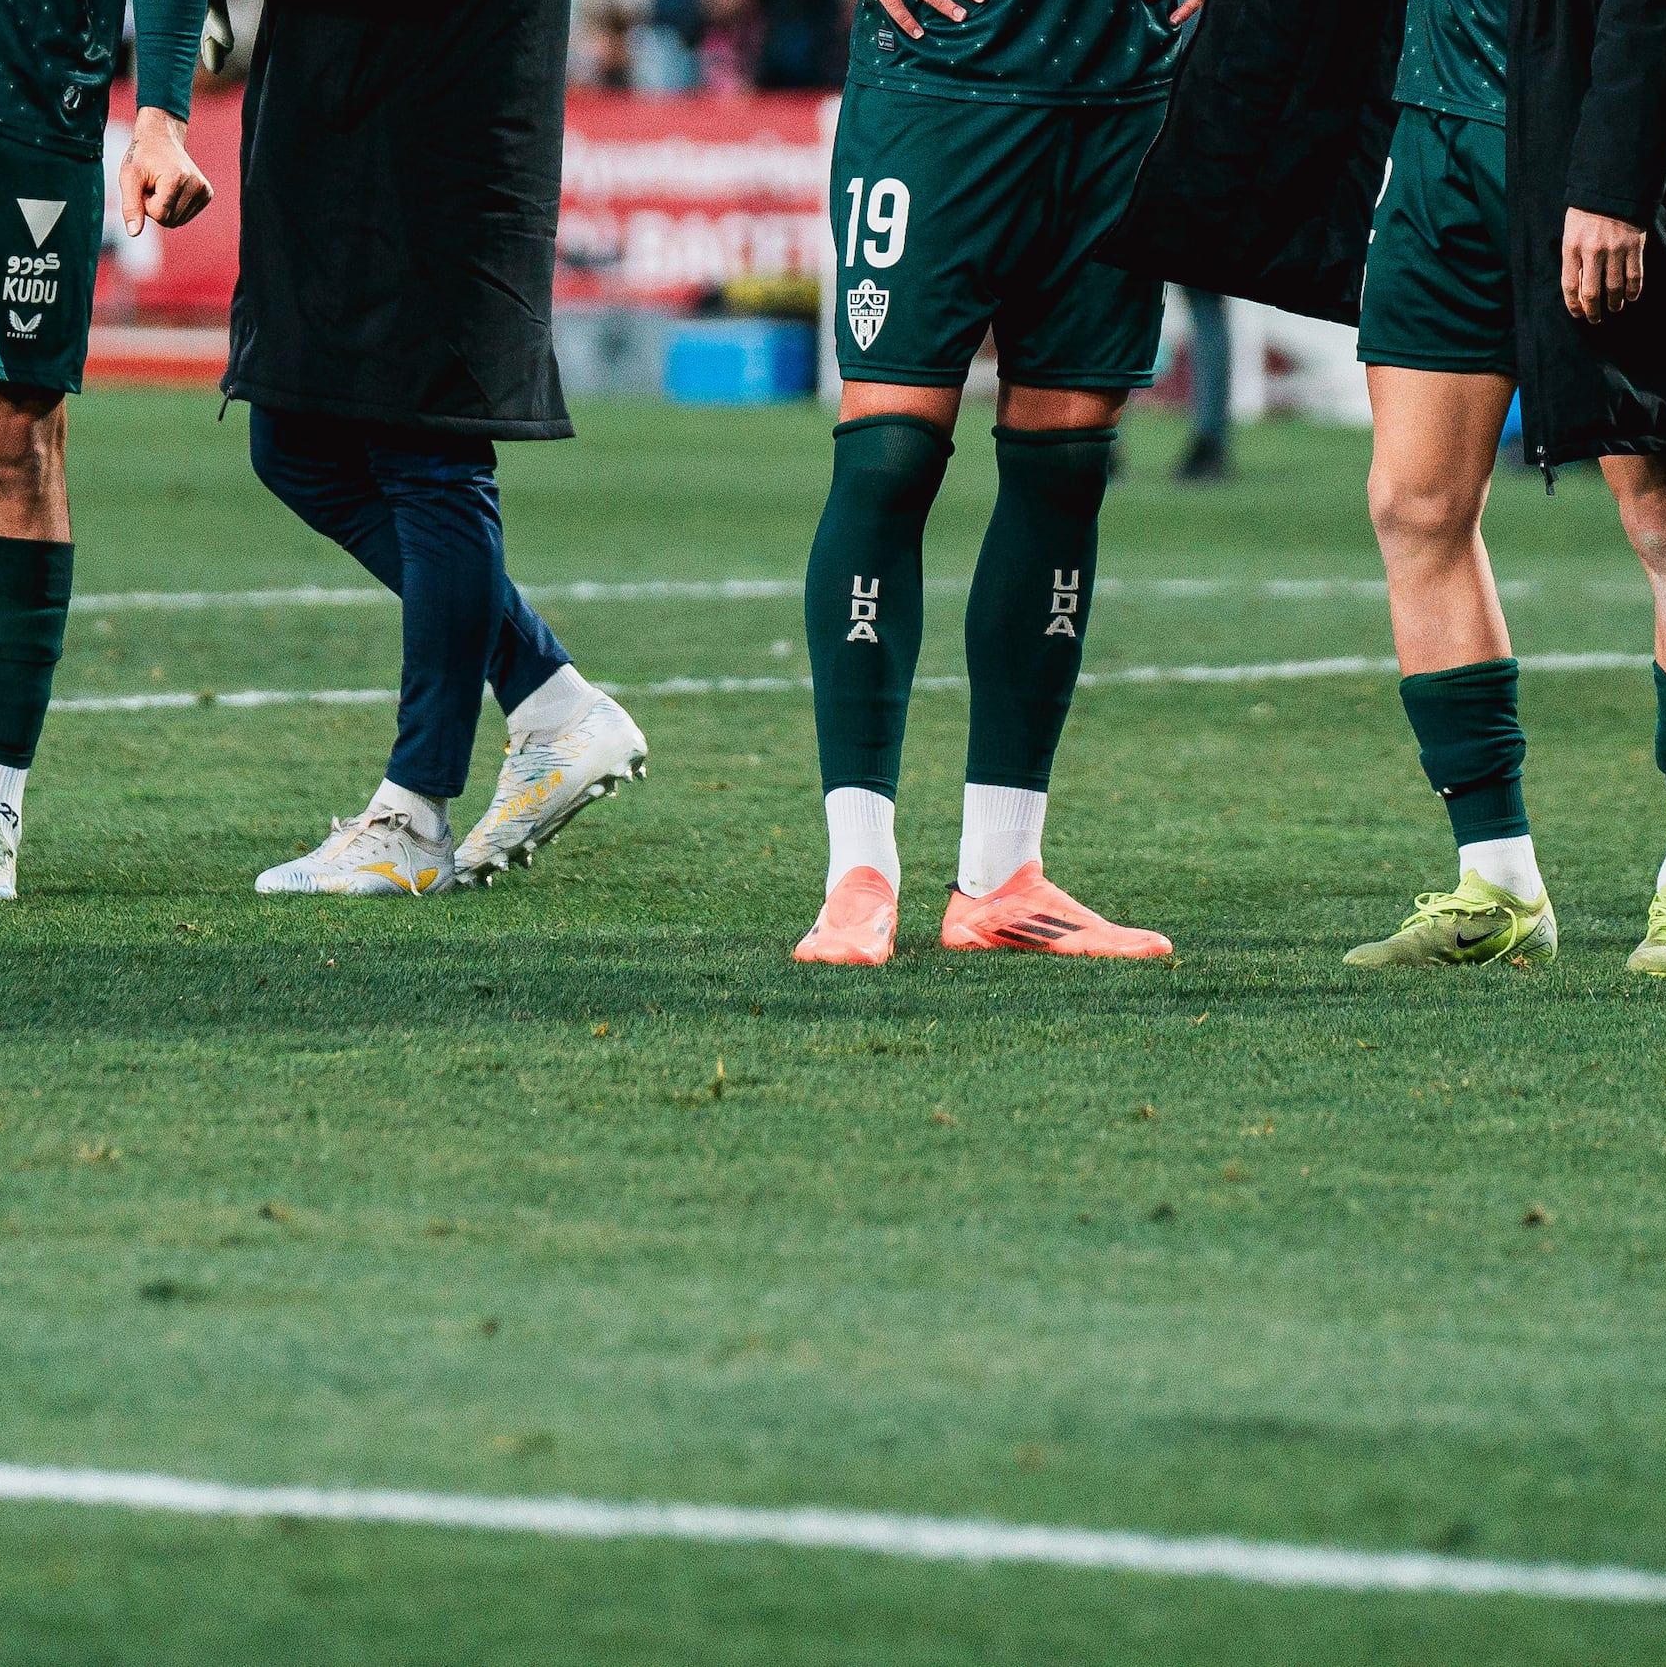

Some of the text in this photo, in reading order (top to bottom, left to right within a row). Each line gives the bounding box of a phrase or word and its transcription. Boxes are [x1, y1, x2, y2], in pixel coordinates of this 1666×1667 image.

[844, 177, 911, 269] 19
[2, 276, 58, 304] KUDU
[846, 574, 880, 644] UDA
[1045, 568, 1080, 638] UDA
